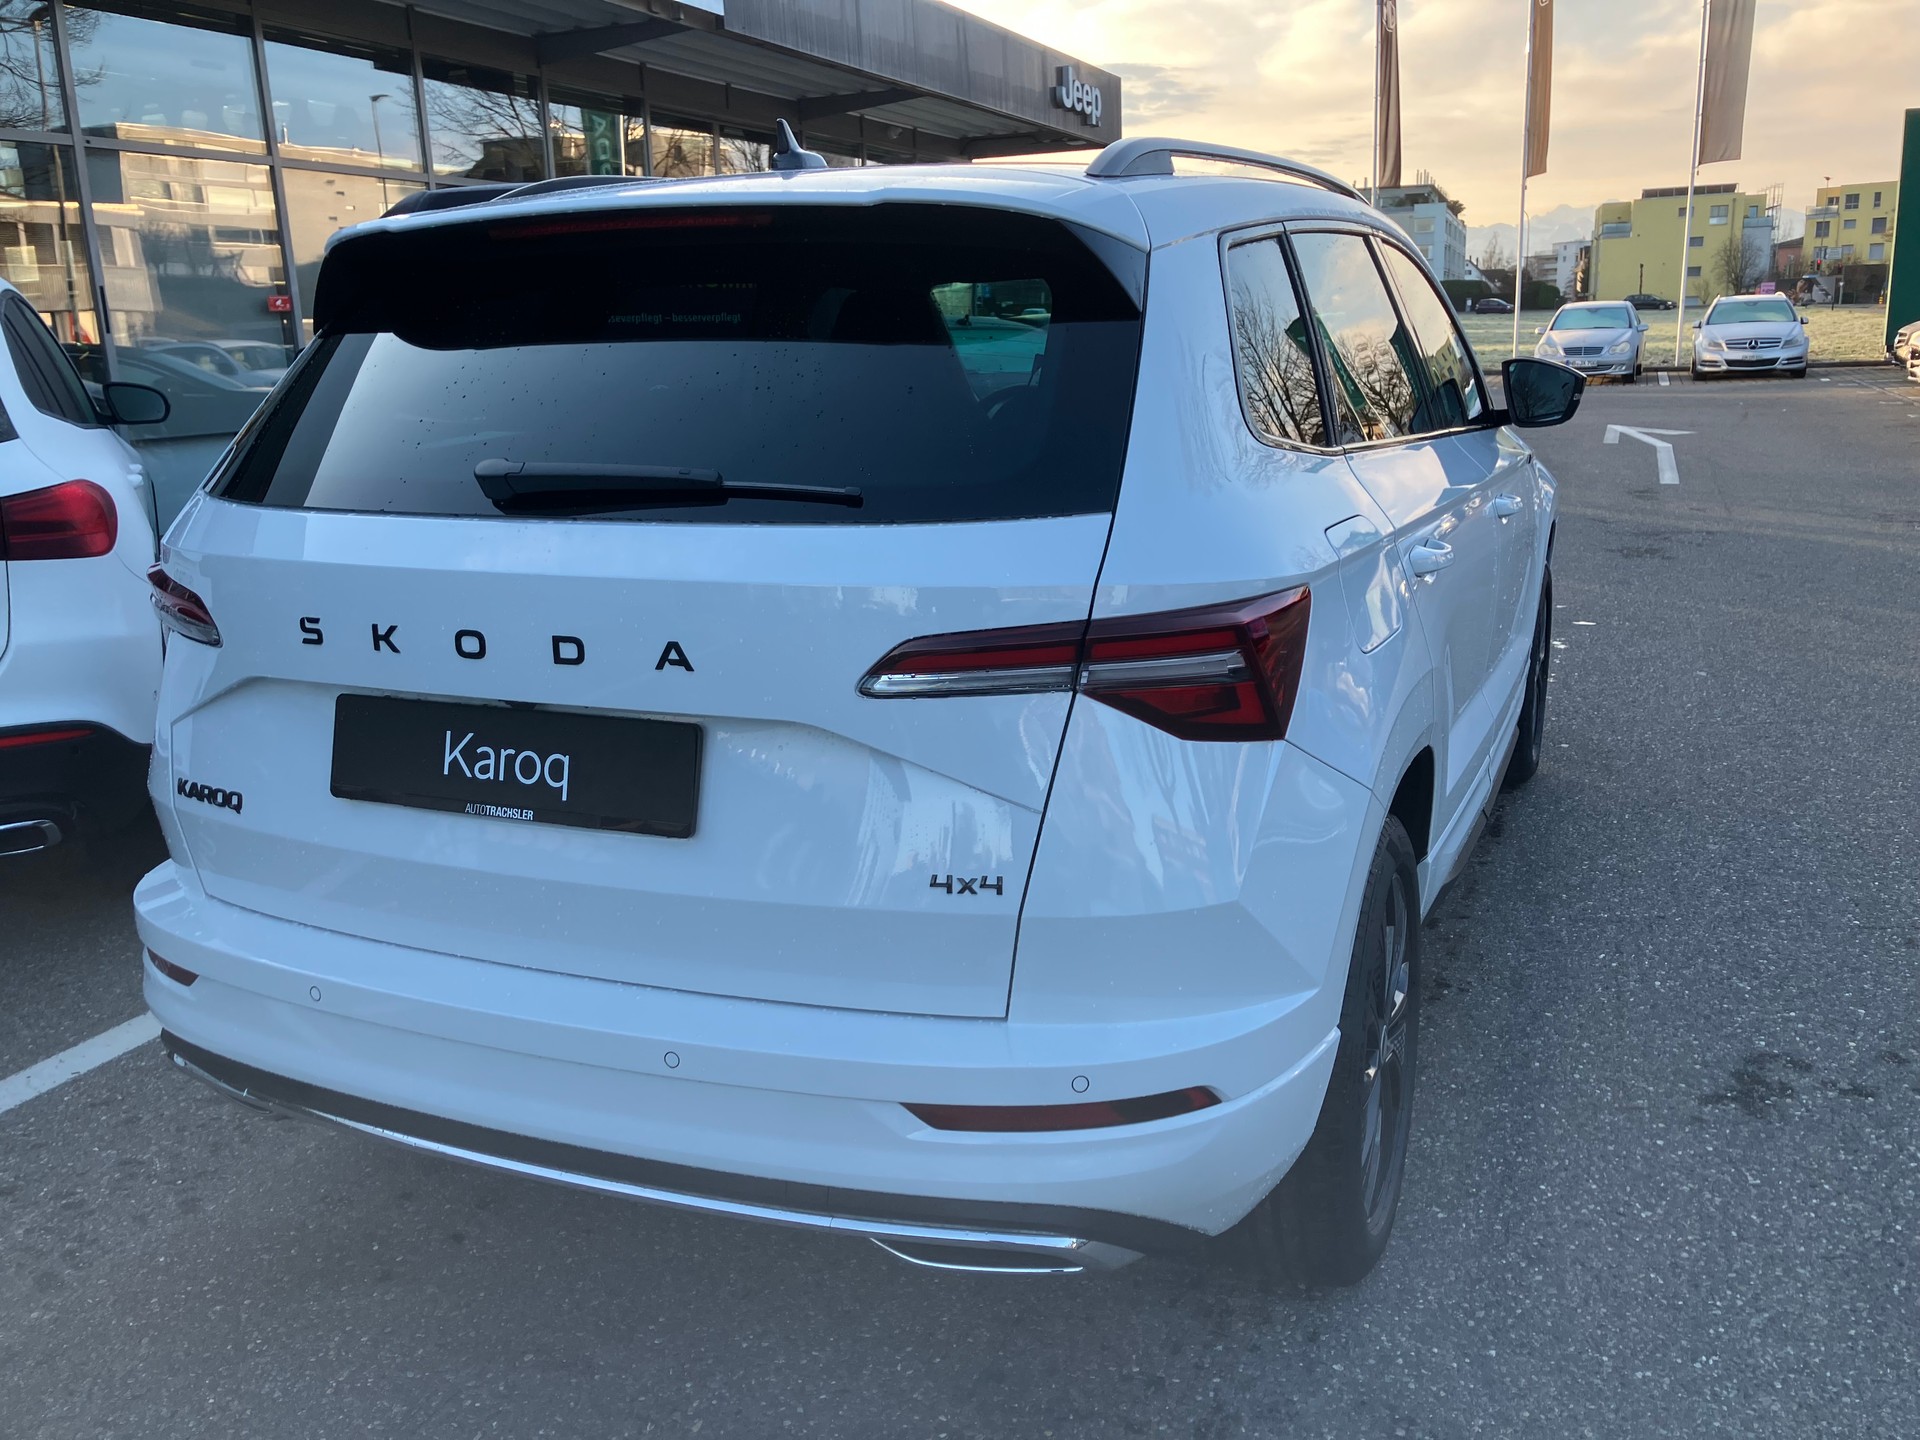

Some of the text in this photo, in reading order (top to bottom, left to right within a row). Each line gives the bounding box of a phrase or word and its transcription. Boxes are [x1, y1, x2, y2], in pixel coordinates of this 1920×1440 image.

[1061, 65, 1102, 126] Jeep
[299, 616, 695, 673] SKODA
[443, 730, 570, 802] Karoq
[177, 777, 243, 815] KAROQ
[464, 803, 534, 821] AUTOTRACHSLER
[929, 874, 1004, 896] 4x4
